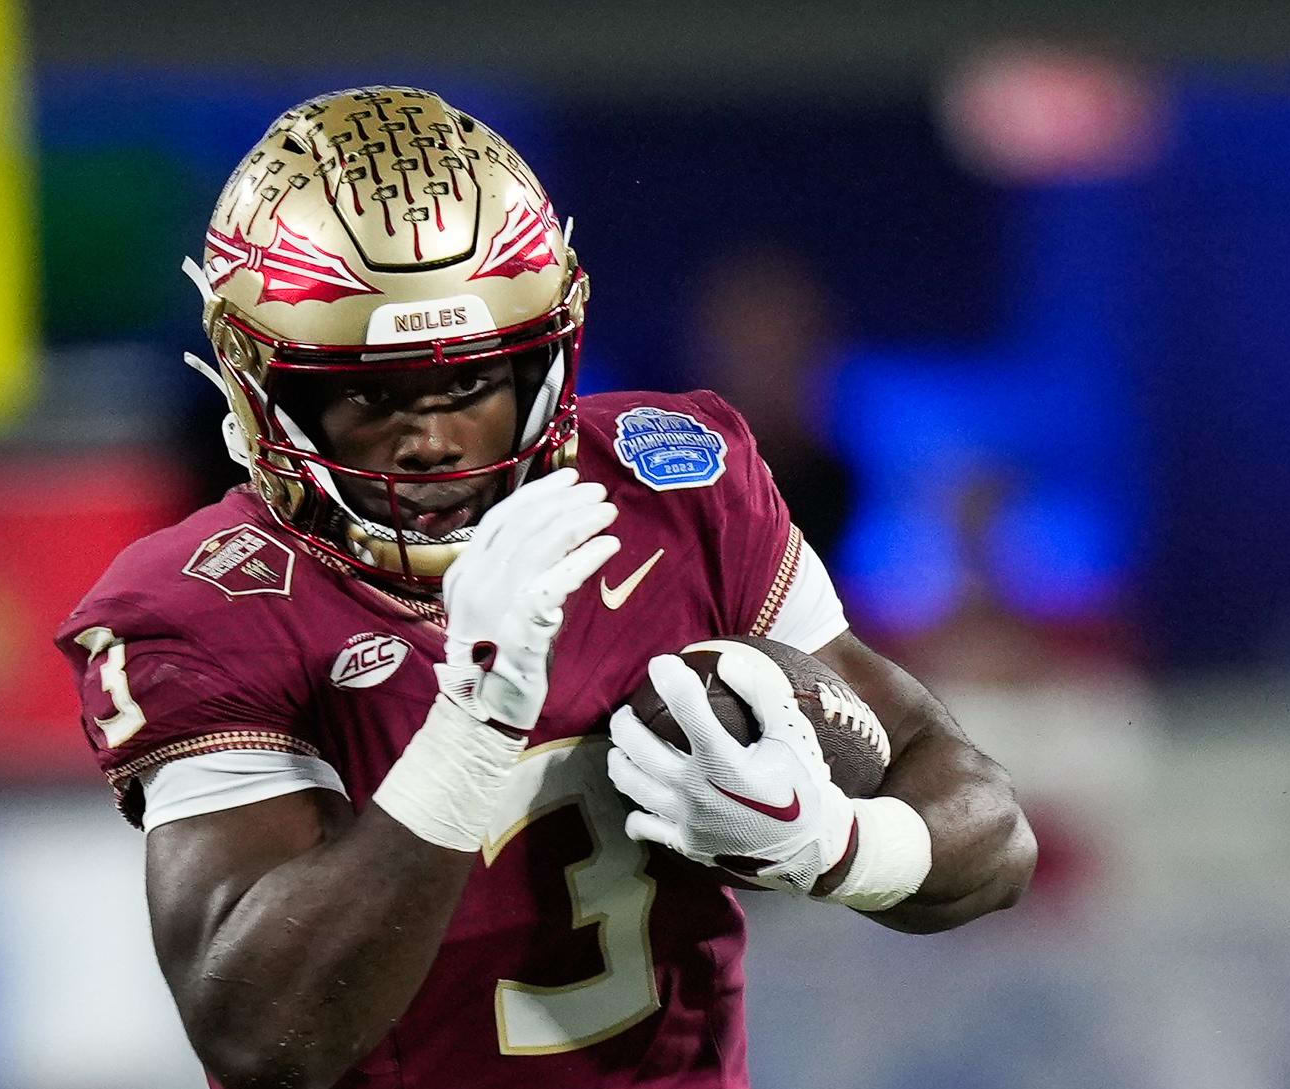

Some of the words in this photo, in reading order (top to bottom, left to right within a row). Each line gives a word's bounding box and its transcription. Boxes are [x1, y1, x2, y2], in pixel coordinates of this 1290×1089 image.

[394, 306, 468, 332] NOLES
[619, 431, 721, 462] CHAMPIONSHIP
[339, 637, 397, 678] ACC
[74, 626, 146, 749] 3
[482, 736, 661, 1056] 3
